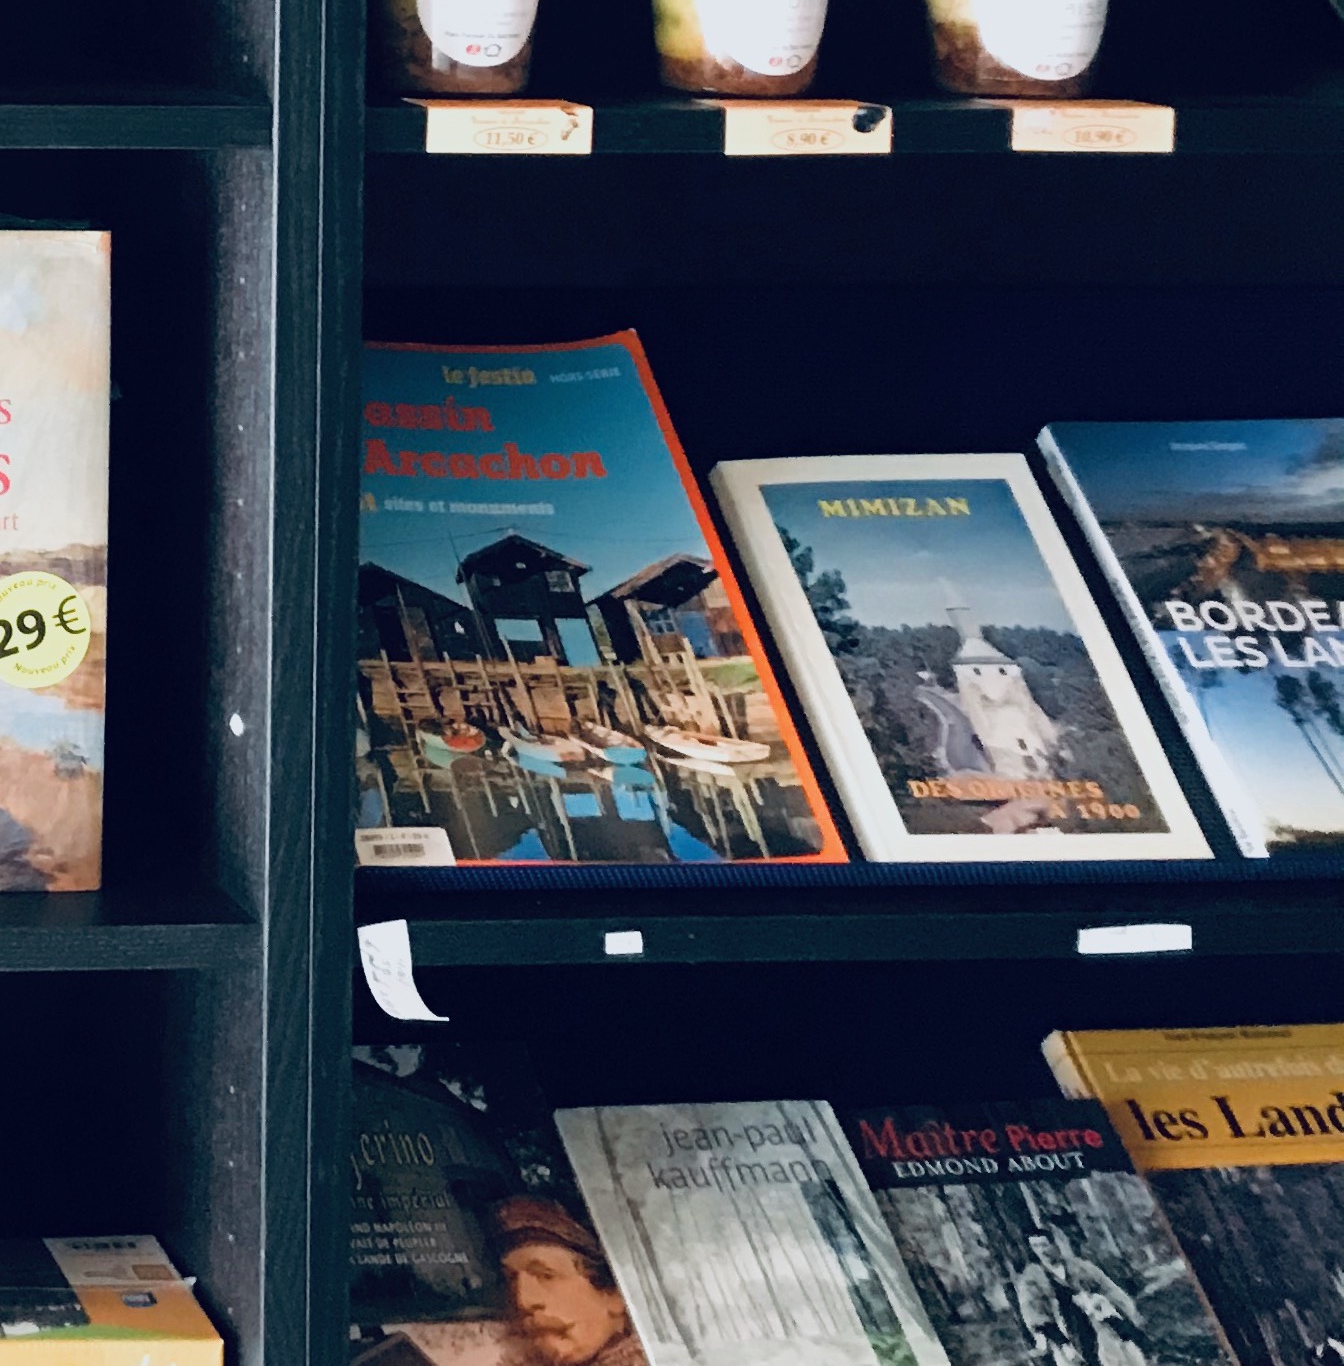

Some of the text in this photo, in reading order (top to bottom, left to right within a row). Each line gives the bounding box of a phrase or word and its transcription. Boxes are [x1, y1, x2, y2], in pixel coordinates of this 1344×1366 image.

[363, 395, 496, 432] assin
[362, 438, 609, 481] Arcachon
[817, 496, 972, 519] MIMIZAN
[51, 594, 87, 635] €
[1164, 600, 1344, 633] BORDE
[1176, 635, 1270, 669] LES
[659, 1115, 818, 1159] jean-paul
[1004, 1122, 1104, 1153] Pierre
[1123, 1097, 1210, 1142] les
[646, 1156, 835, 1194] kauffmann
[891, 1150, 1087, 1179] EDMOND ABOUT
